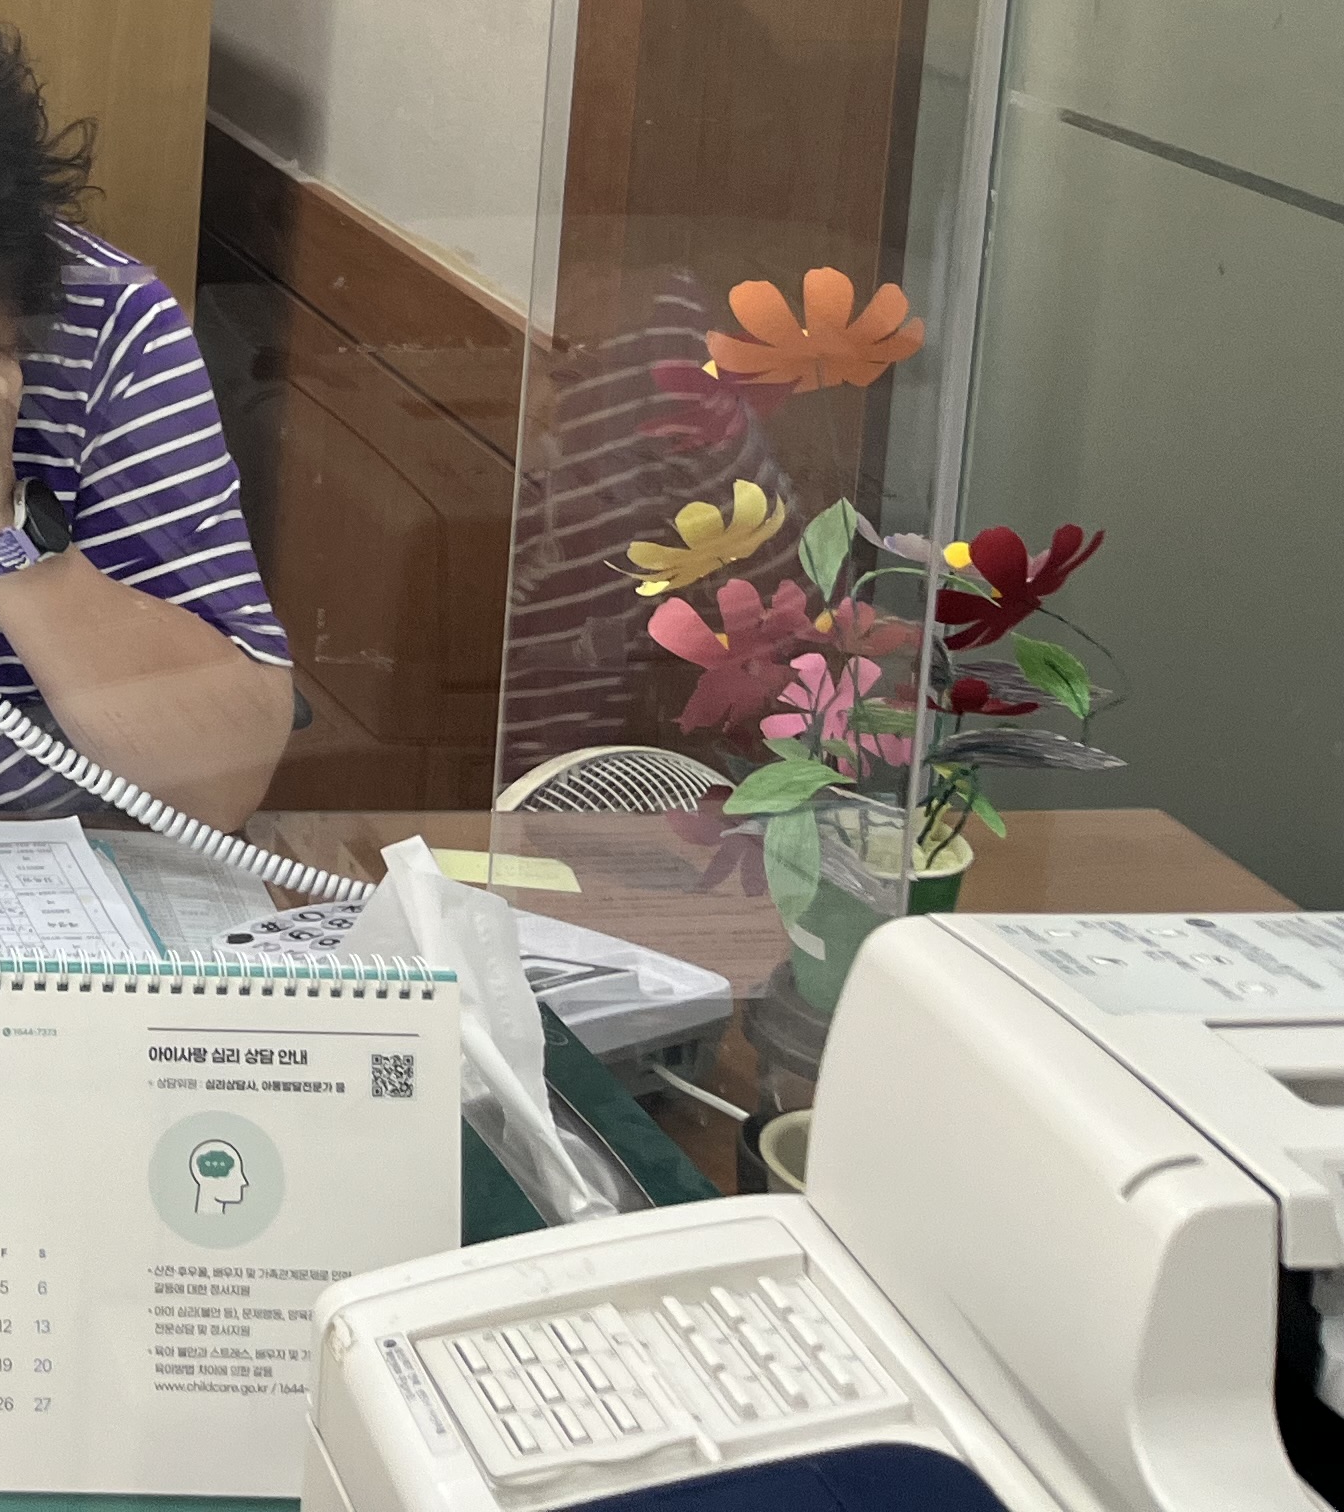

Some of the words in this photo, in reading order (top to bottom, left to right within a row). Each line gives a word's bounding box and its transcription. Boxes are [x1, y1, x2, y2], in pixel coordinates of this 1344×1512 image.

[149, 1047, 207, 1063] 아이사랑
[212, 1048, 240, 1064] 심리
[245, 1049, 274, 1064] 상담
[278, 1050, 308, 1065] 안내
[0, 1280, 9, 1294] 5
[37, 1281, 47, 1295] 6
[35, 1319, 50, 1333] 13
[34, 1358, 52, 1372] 20
[34, 1397, 51, 1412] 27
